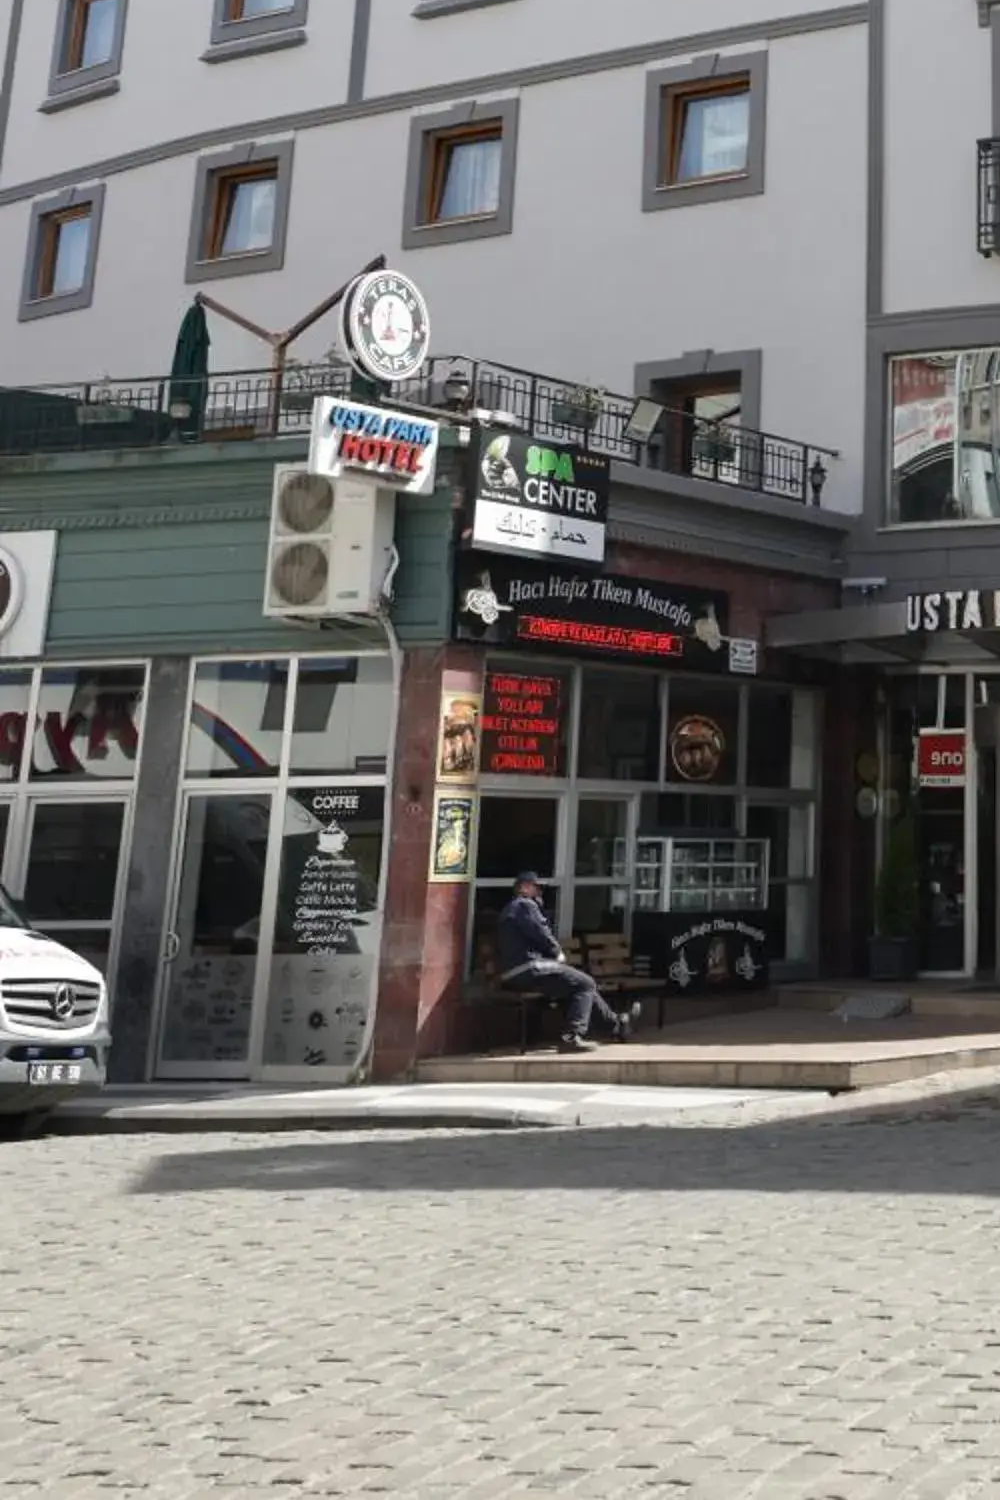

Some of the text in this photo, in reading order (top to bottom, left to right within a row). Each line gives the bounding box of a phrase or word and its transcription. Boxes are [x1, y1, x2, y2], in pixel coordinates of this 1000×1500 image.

[329, 406, 433, 448] USTA PARK
[338, 434, 424, 474] HOTEL
[525, 445, 575, 482] SPA
[524, 478, 598, 514] CENTER
[509, 580, 544, 602] Hacı
[592, 580, 633, 605] Tiken
[635, 587, 691, 627] Mustafa
[906, 591, 983, 632] USTA
[312, 795, 360, 809] COFFEE
